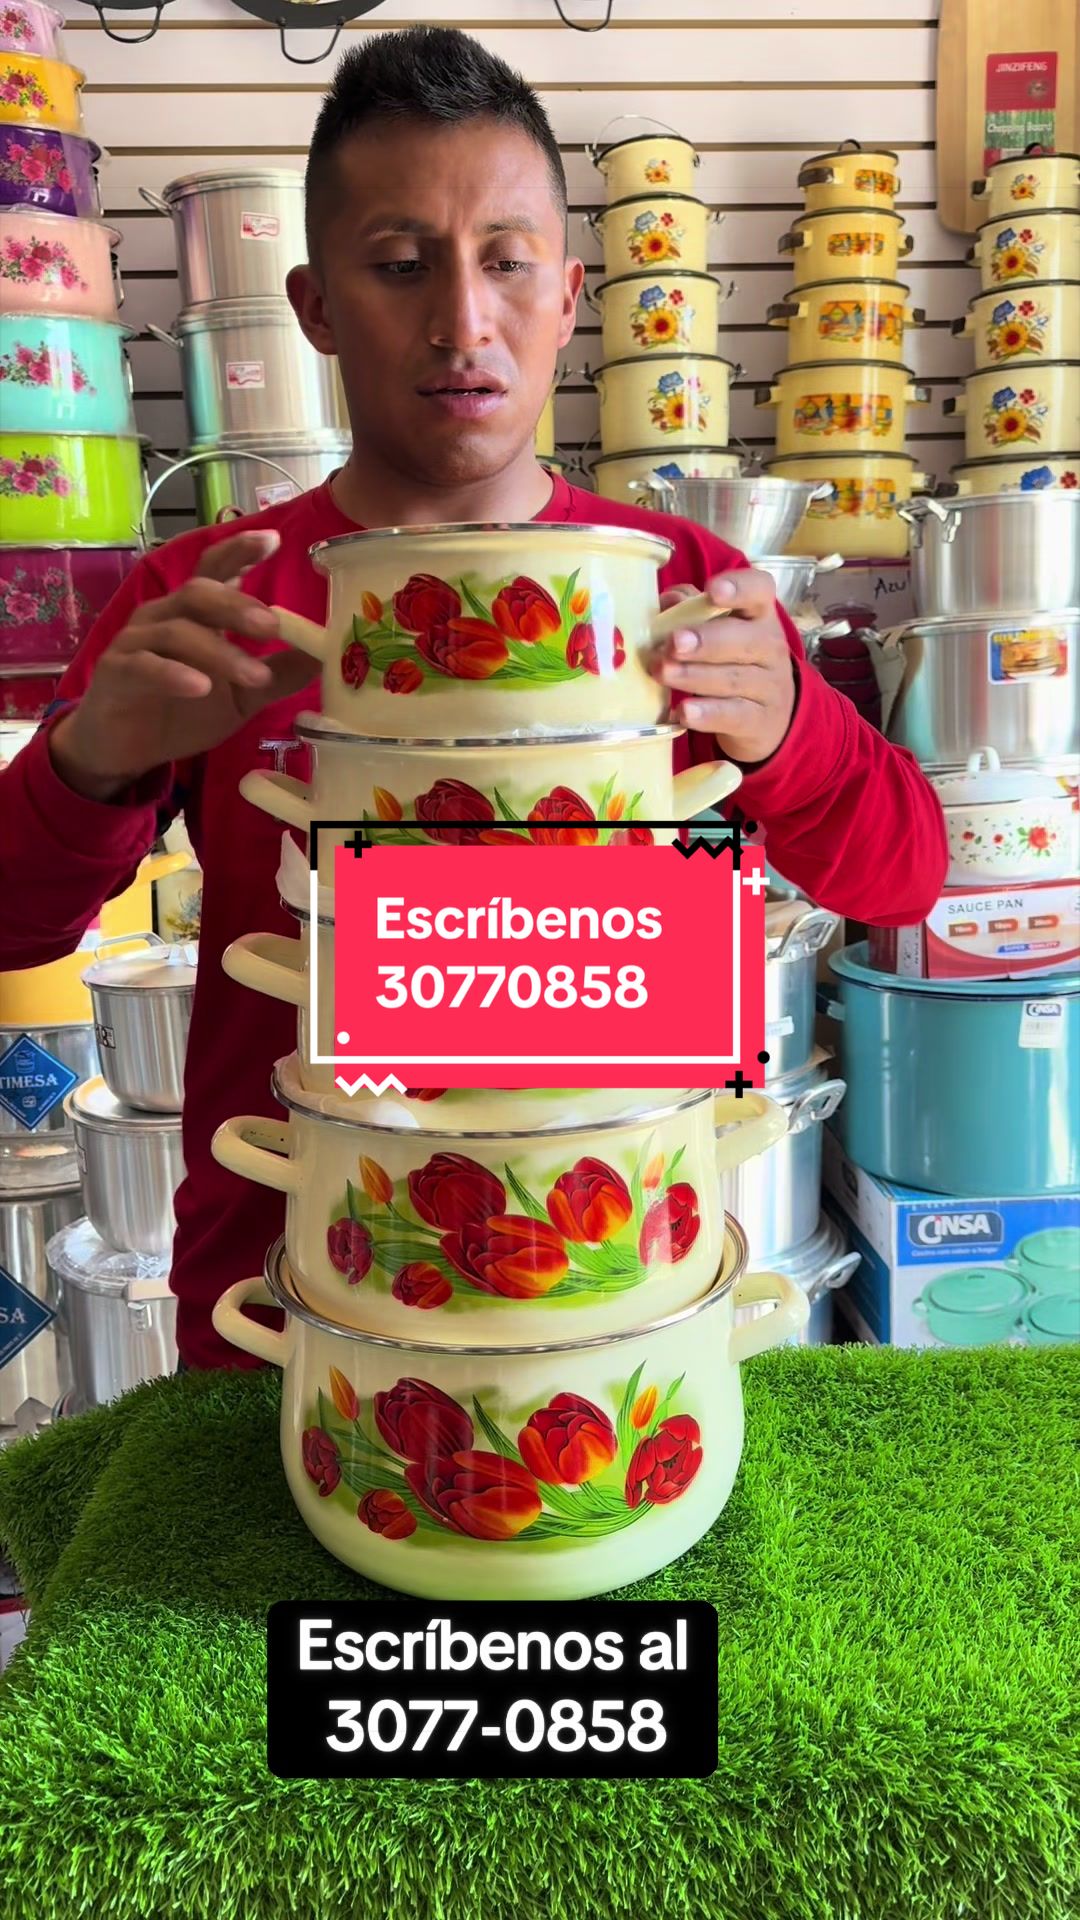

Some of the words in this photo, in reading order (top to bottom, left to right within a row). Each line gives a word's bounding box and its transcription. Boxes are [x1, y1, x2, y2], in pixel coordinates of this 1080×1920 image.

[948, 902, 993, 914] SAUCE
[997, 899, 1024, 909] PAN
[918, 1213, 992, 1244] CINSA
